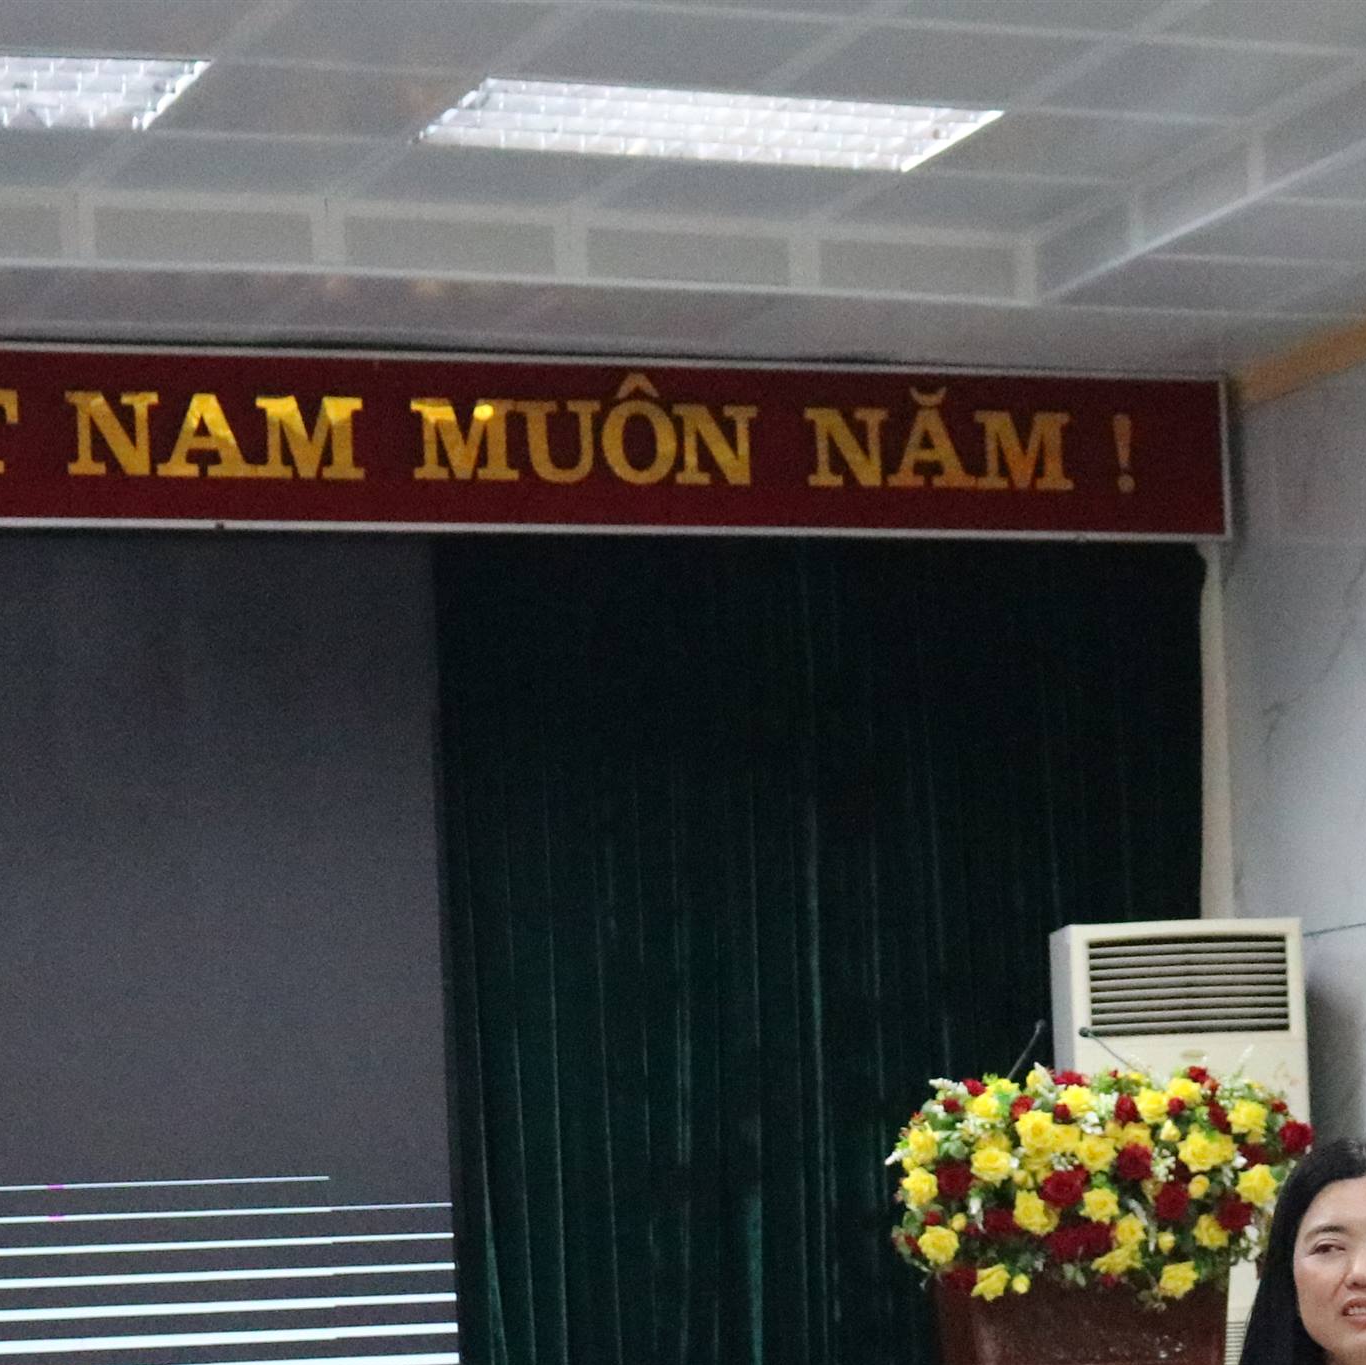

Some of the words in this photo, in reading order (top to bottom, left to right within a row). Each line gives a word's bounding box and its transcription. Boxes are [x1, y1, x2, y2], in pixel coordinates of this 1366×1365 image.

[66, 391, 366, 481] NAM
[410, 373, 754, 486] MUÔN
[805, 387, 1075, 492] NĂM
[1111, 414, 1135, 494] !
